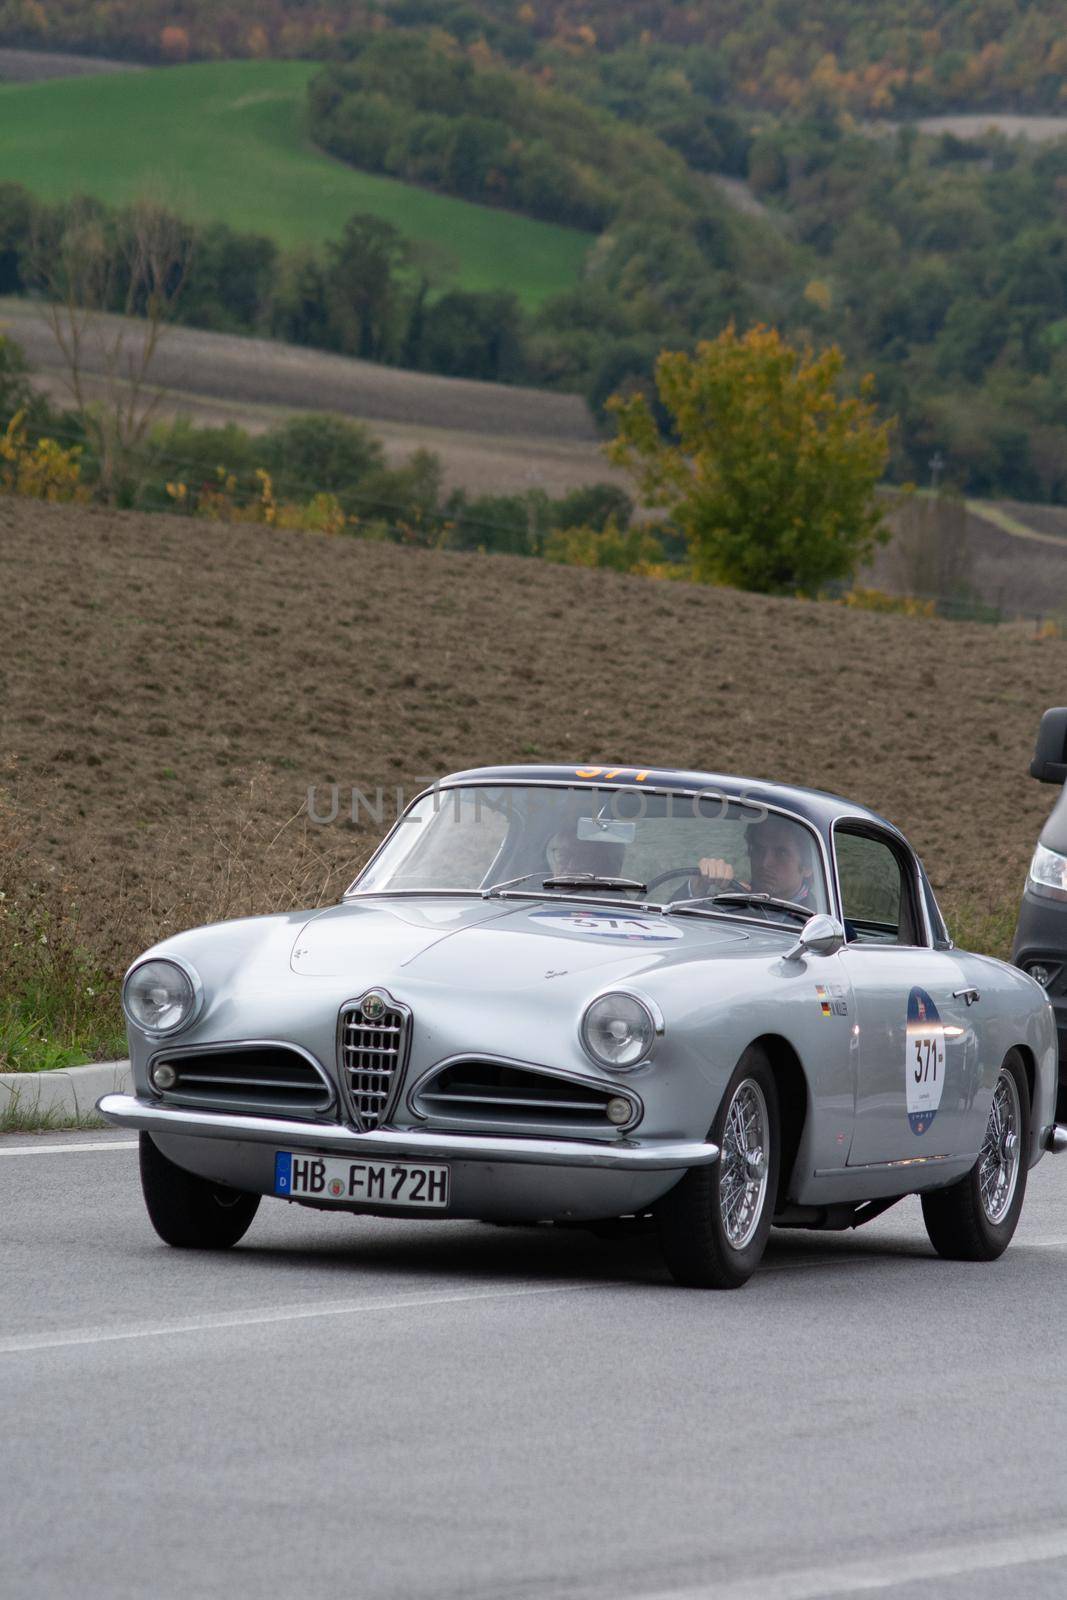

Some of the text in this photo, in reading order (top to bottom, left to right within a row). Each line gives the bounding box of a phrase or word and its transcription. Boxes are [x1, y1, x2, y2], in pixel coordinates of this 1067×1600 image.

[915, 1039, 936, 1083] 371
[279, 1176, 287, 1187] D
[292, 1159, 326, 1193] HB
